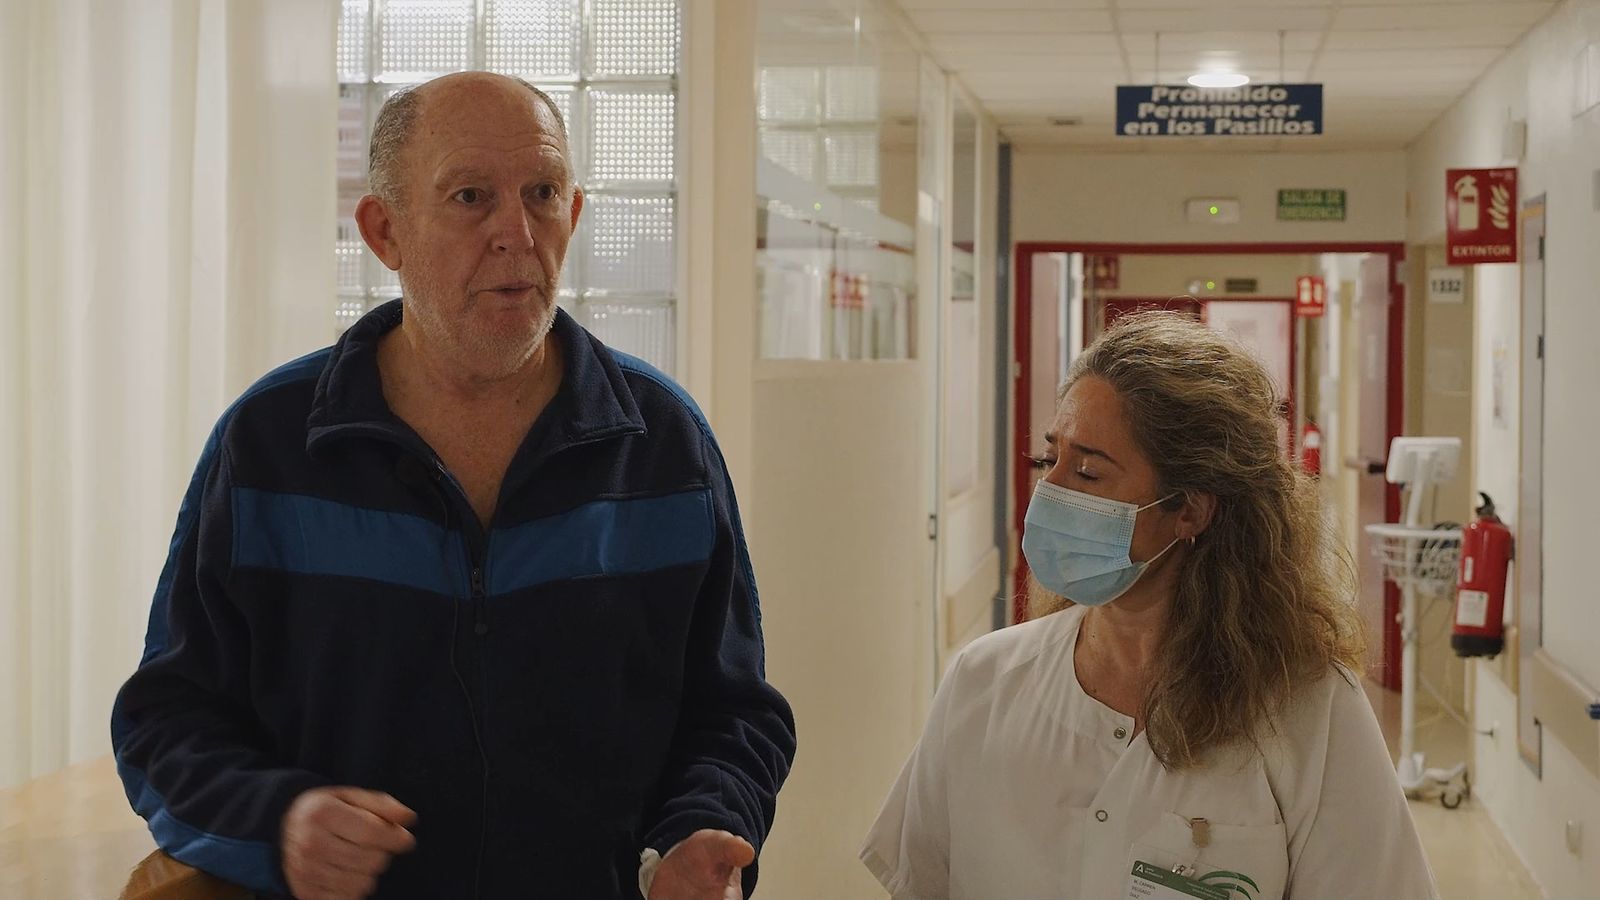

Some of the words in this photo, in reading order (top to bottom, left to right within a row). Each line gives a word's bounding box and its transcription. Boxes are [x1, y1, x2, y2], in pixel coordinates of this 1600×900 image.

[1151, 86, 1289, 102] Prohibido
[1138, 102, 1301, 119] Permanecer
[1124, 120, 1159, 135] en
[1167, 118, 1206, 135] los
[1214, 118, 1315, 135] Pasillos
[1451, 245, 1512, 258] EXTINTOR
